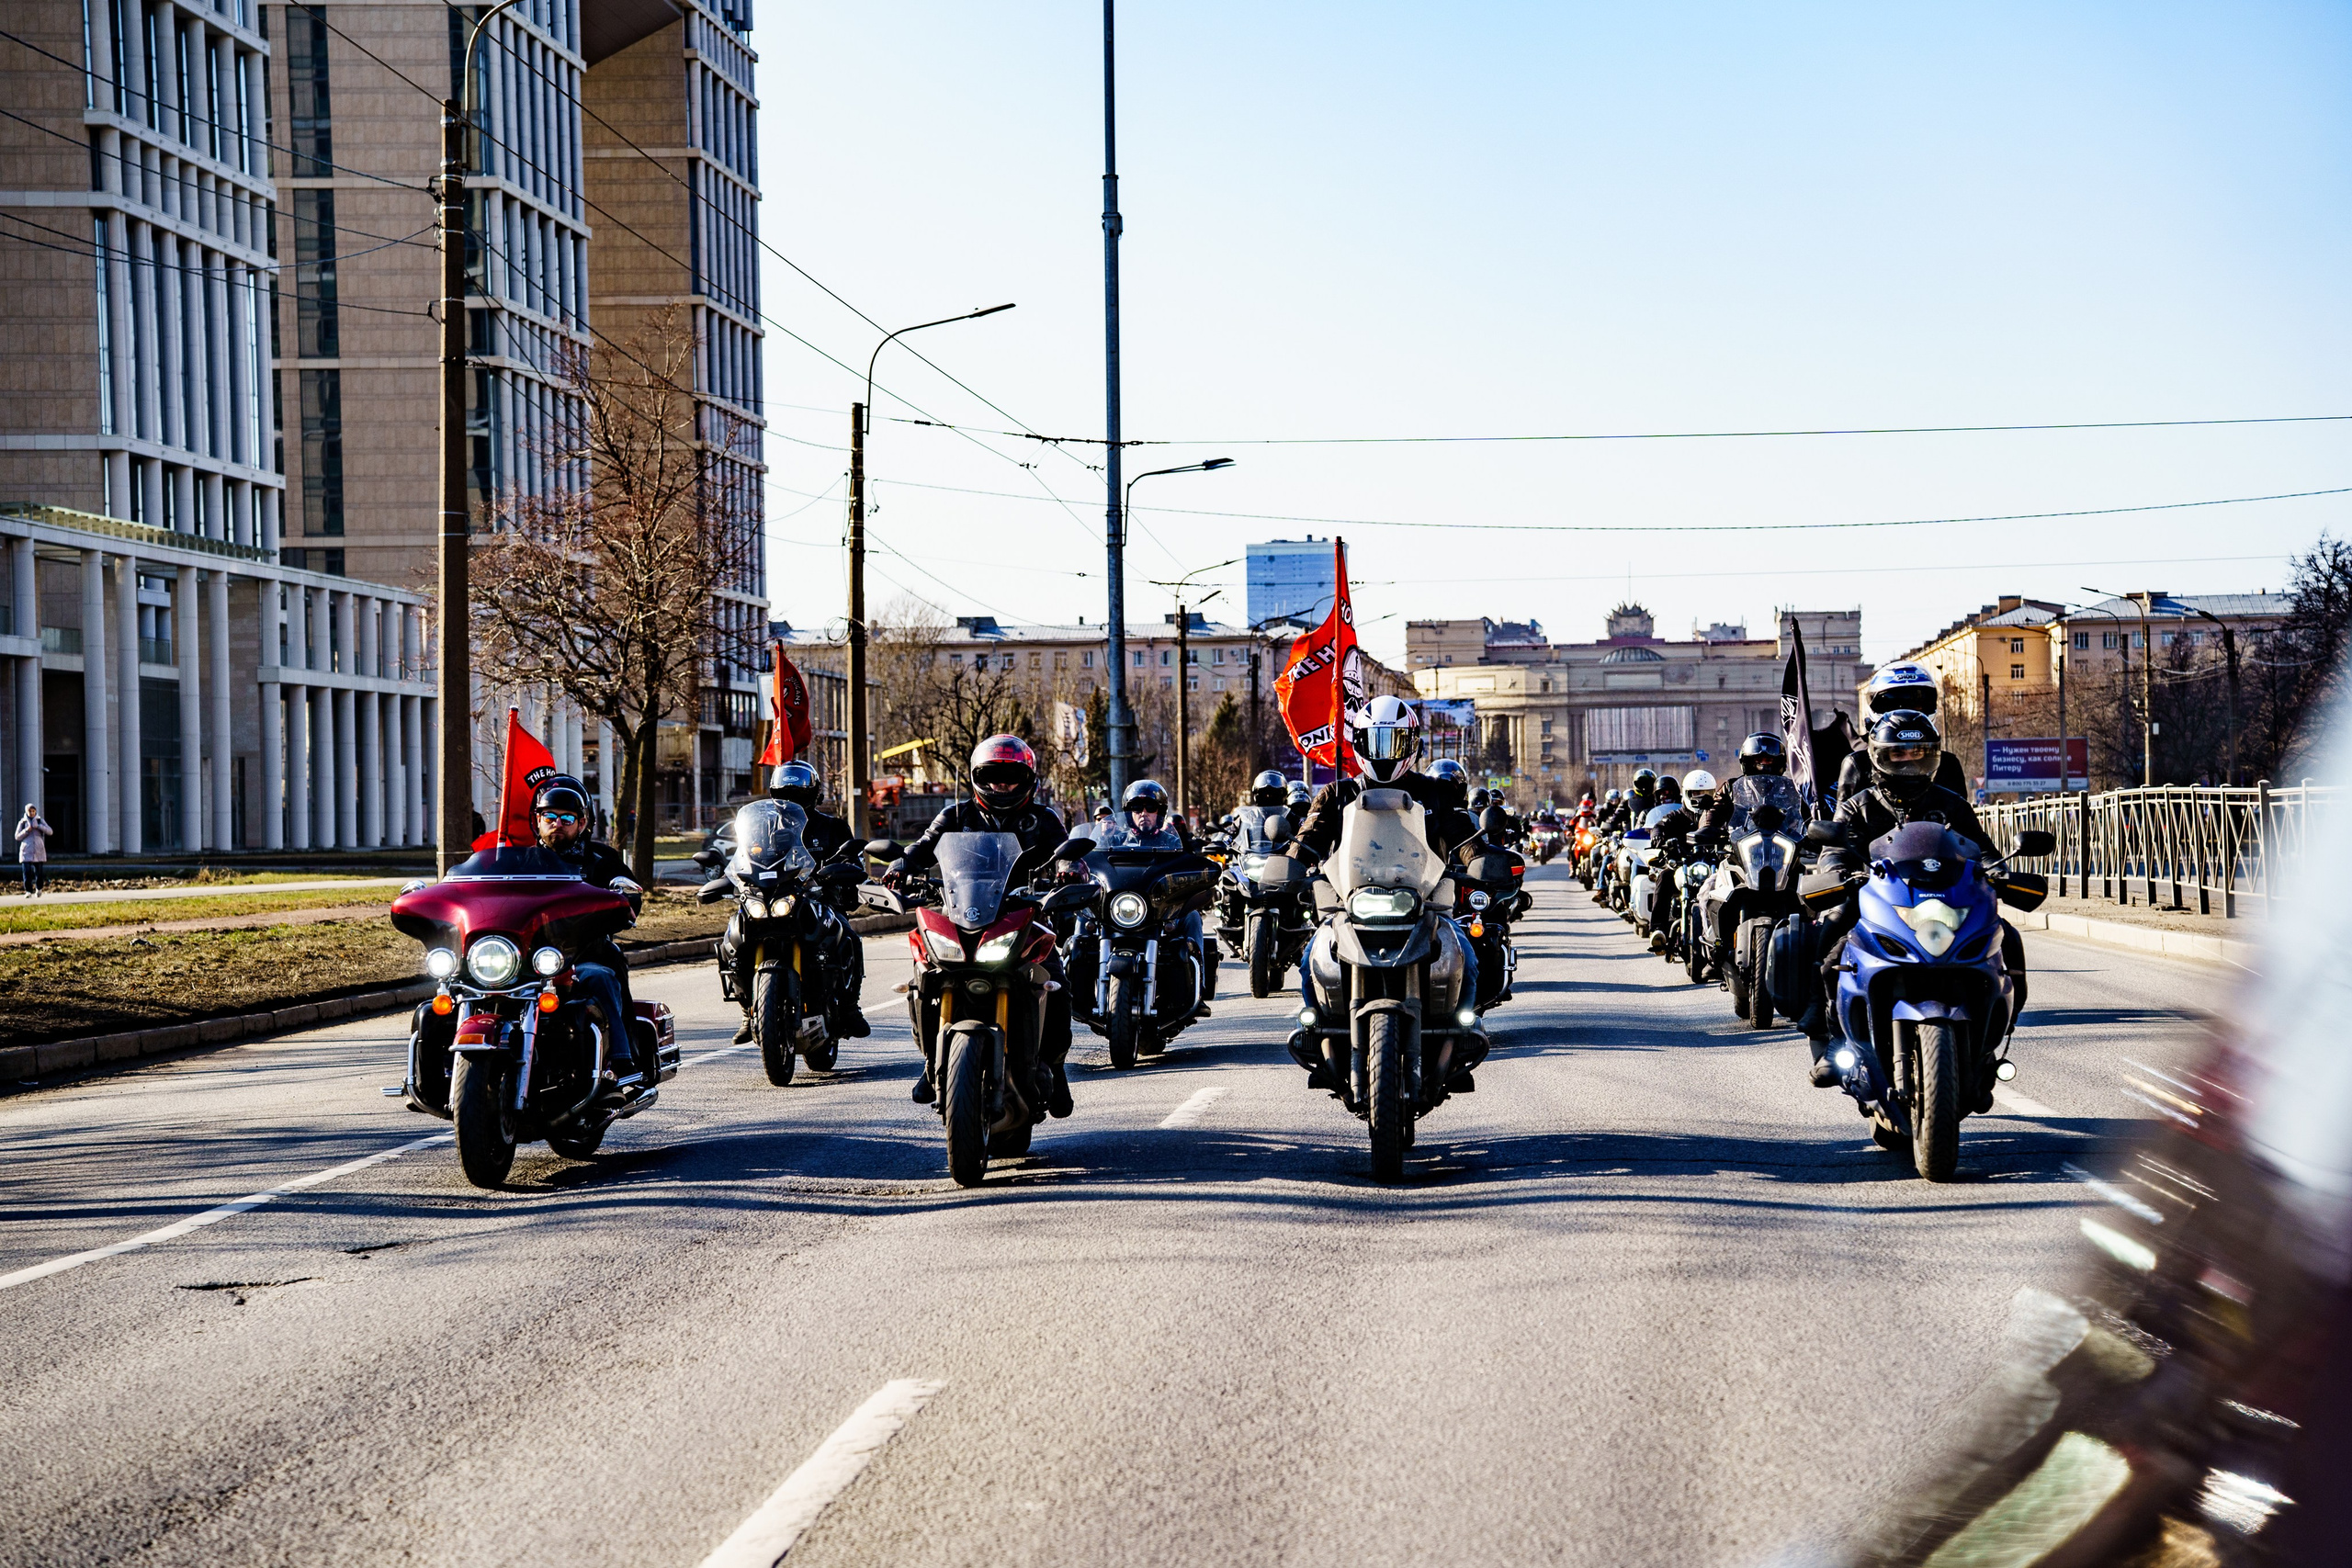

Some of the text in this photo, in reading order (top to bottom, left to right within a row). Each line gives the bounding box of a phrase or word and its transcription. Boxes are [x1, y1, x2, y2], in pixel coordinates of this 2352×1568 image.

[1287, 657, 1321, 683] THE
[2002, 746, 2030, 755] Нужен
[2030, 746, 2060, 755] твоему
[1992, 755, 2027, 764] бизнесу,
[1992, 764, 2022, 773] Питеру
[526, 769, 546, 784] THE
